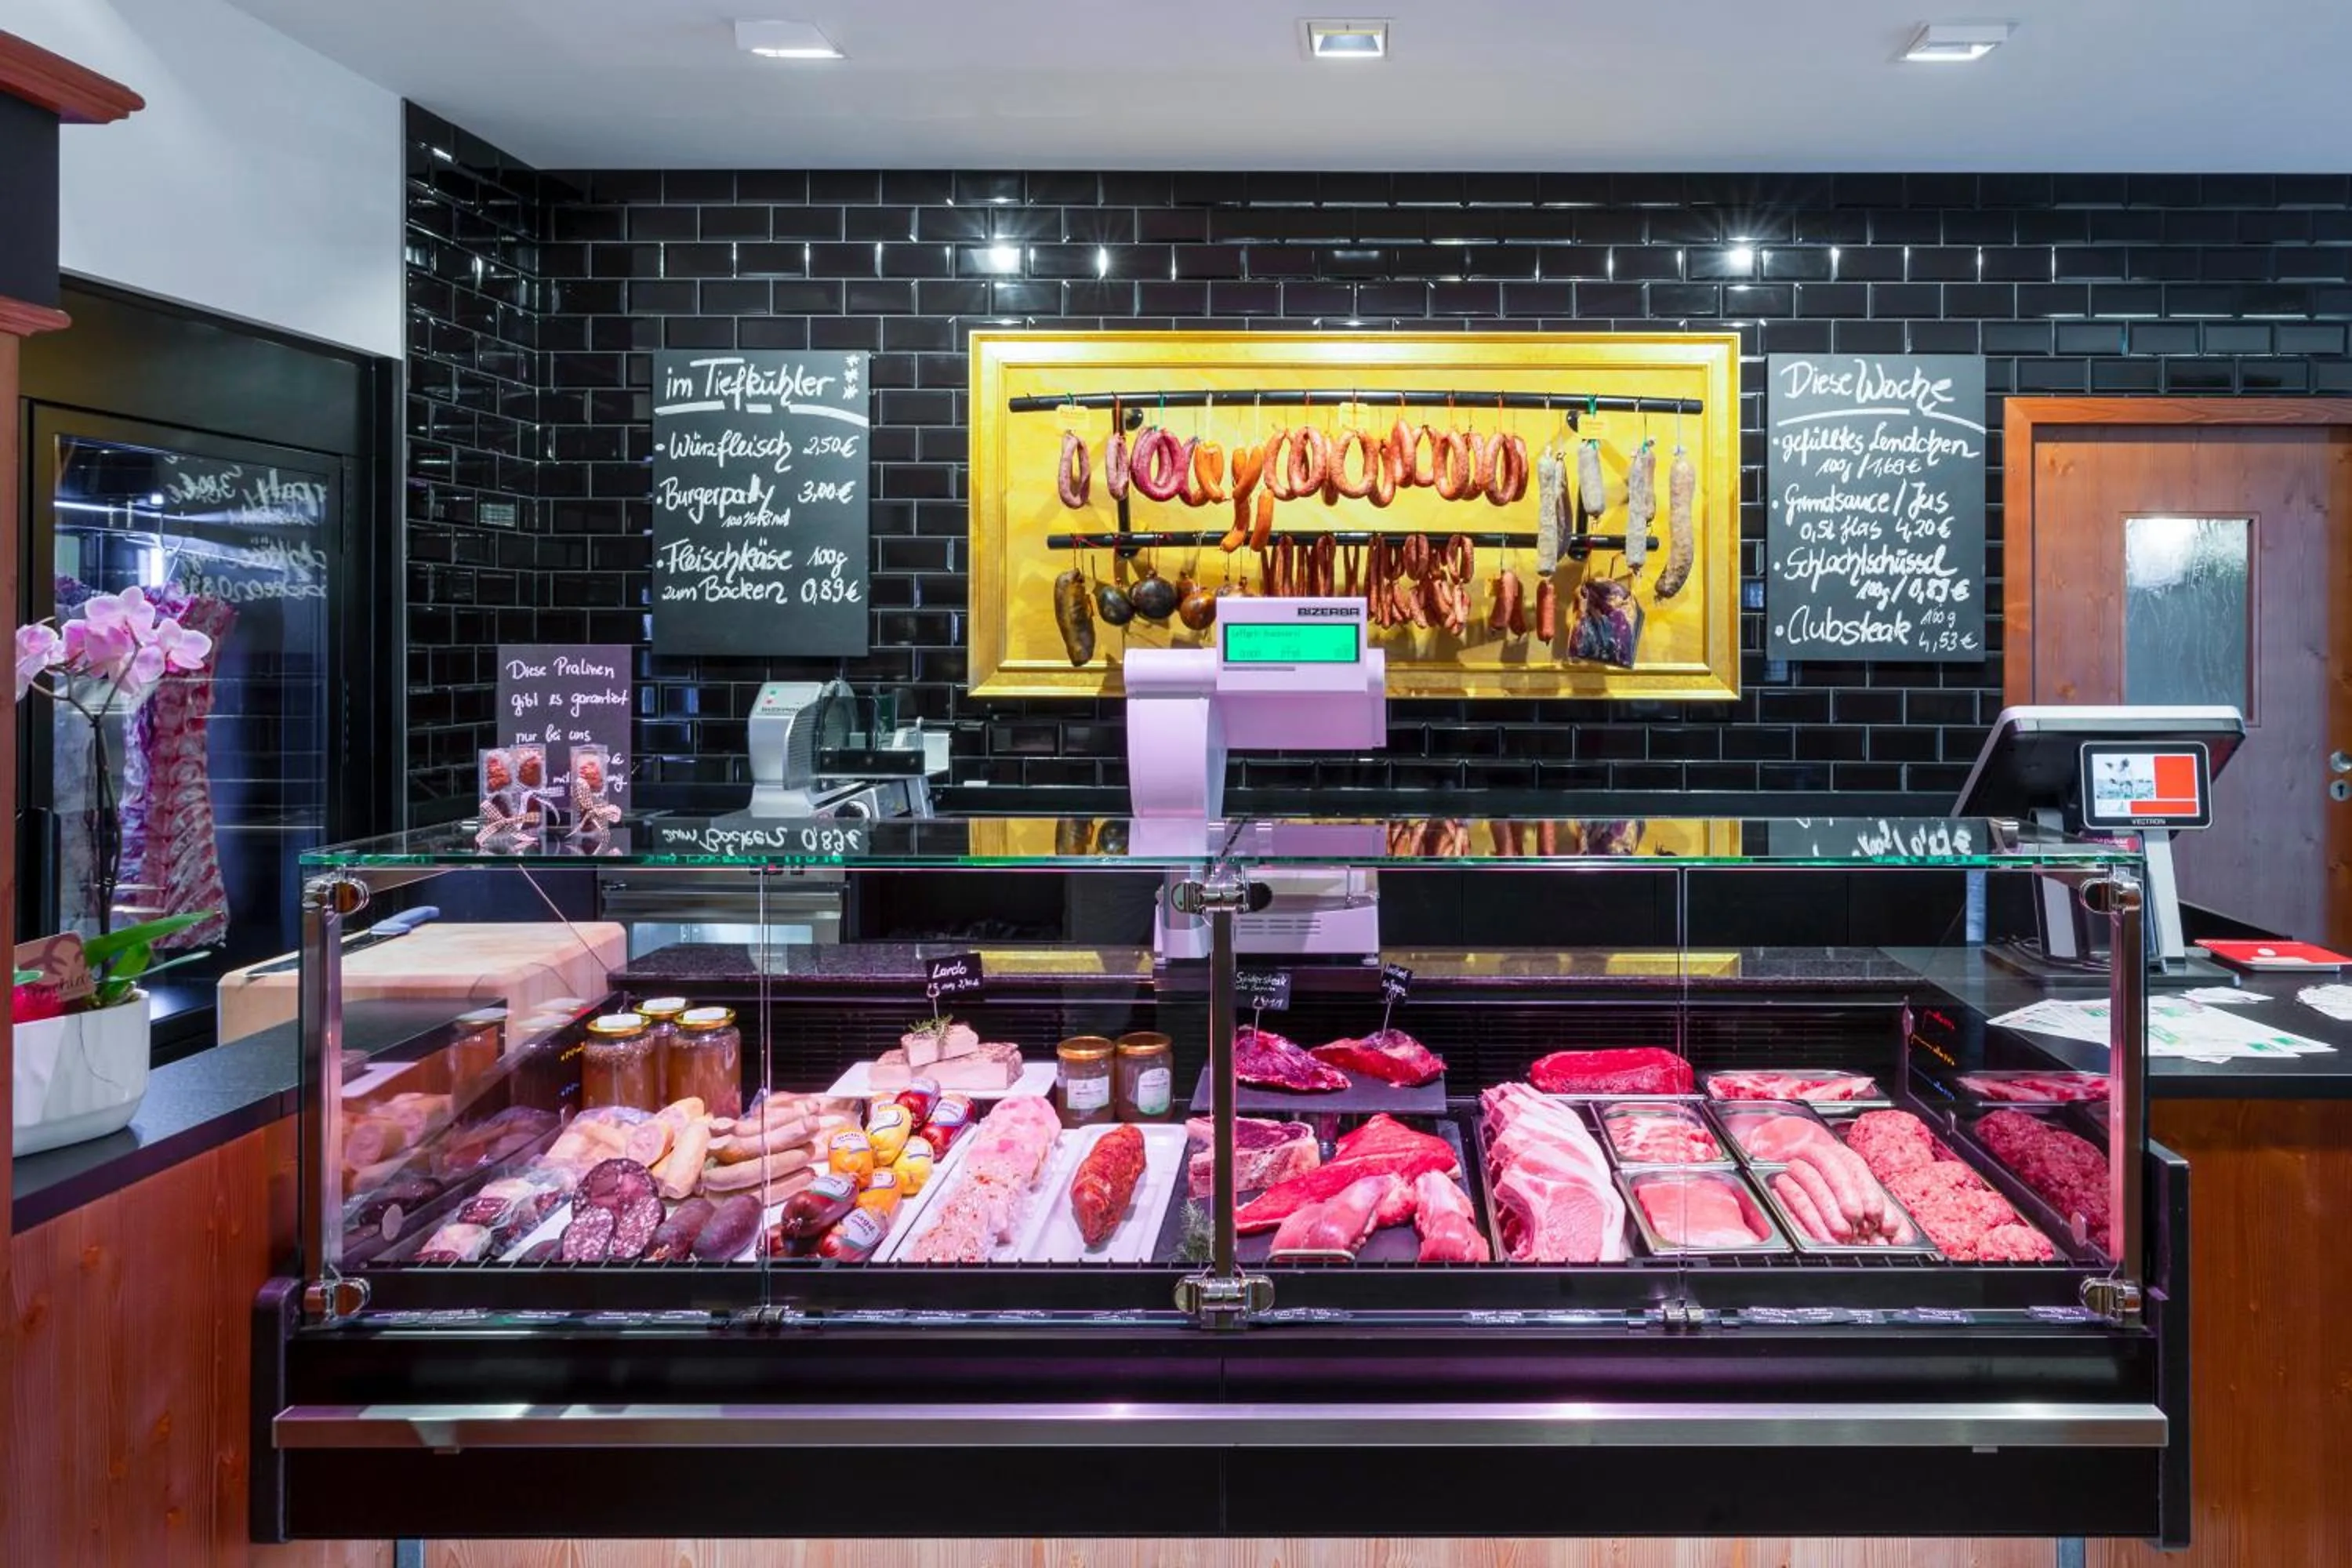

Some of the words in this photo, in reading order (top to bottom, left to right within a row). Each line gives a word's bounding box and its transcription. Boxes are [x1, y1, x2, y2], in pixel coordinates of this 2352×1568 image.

[690, 358, 836, 412] Tiefkühler
[1780, 361, 1853, 399] Diese
[1853, 358, 1955, 414] Woche
[670, 430, 793, 474] Würzfleisch
[803, 435, 859, 459] 2,50€
[1782, 424, 1864, 466] gefülltes
[1868, 421, 1980, 466] Lendchen
[1815, 457, 1853, 484] 100g
[797, 480, 856, 504] 3,00€
[1784, 483, 1891, 527] Grundsauce
[1907, 481, 1950, 520] Jus
[1894, 516, 1955, 543] 4,20€
[660, 537, 793, 583] Fleischkäse
[806, 546, 848, 578] 100g
[1784, 543, 1958, 593] Schlachtschüssel
[662, 586, 698, 601] zum
[698, 575, 788, 604] Backen
[800, 578, 862, 605] 0,89€
[1856, 579, 1891, 612] 100g
[1298, 608, 1360, 616] BIZERBA
[1788, 604, 1912, 645] Clubsteak
[506, 659, 546, 680] Diese
[553, 656, 615, 678] Pralinen
[511, 692, 539, 717] gibt
[548, 693, 563, 706] es
[570, 688, 629, 718] garantiert
[515, 731, 538, 744] nur
[545, 724, 562, 742] bei
[568, 728, 592, 742] uns
[931, 960, 967, 979] Lardo
